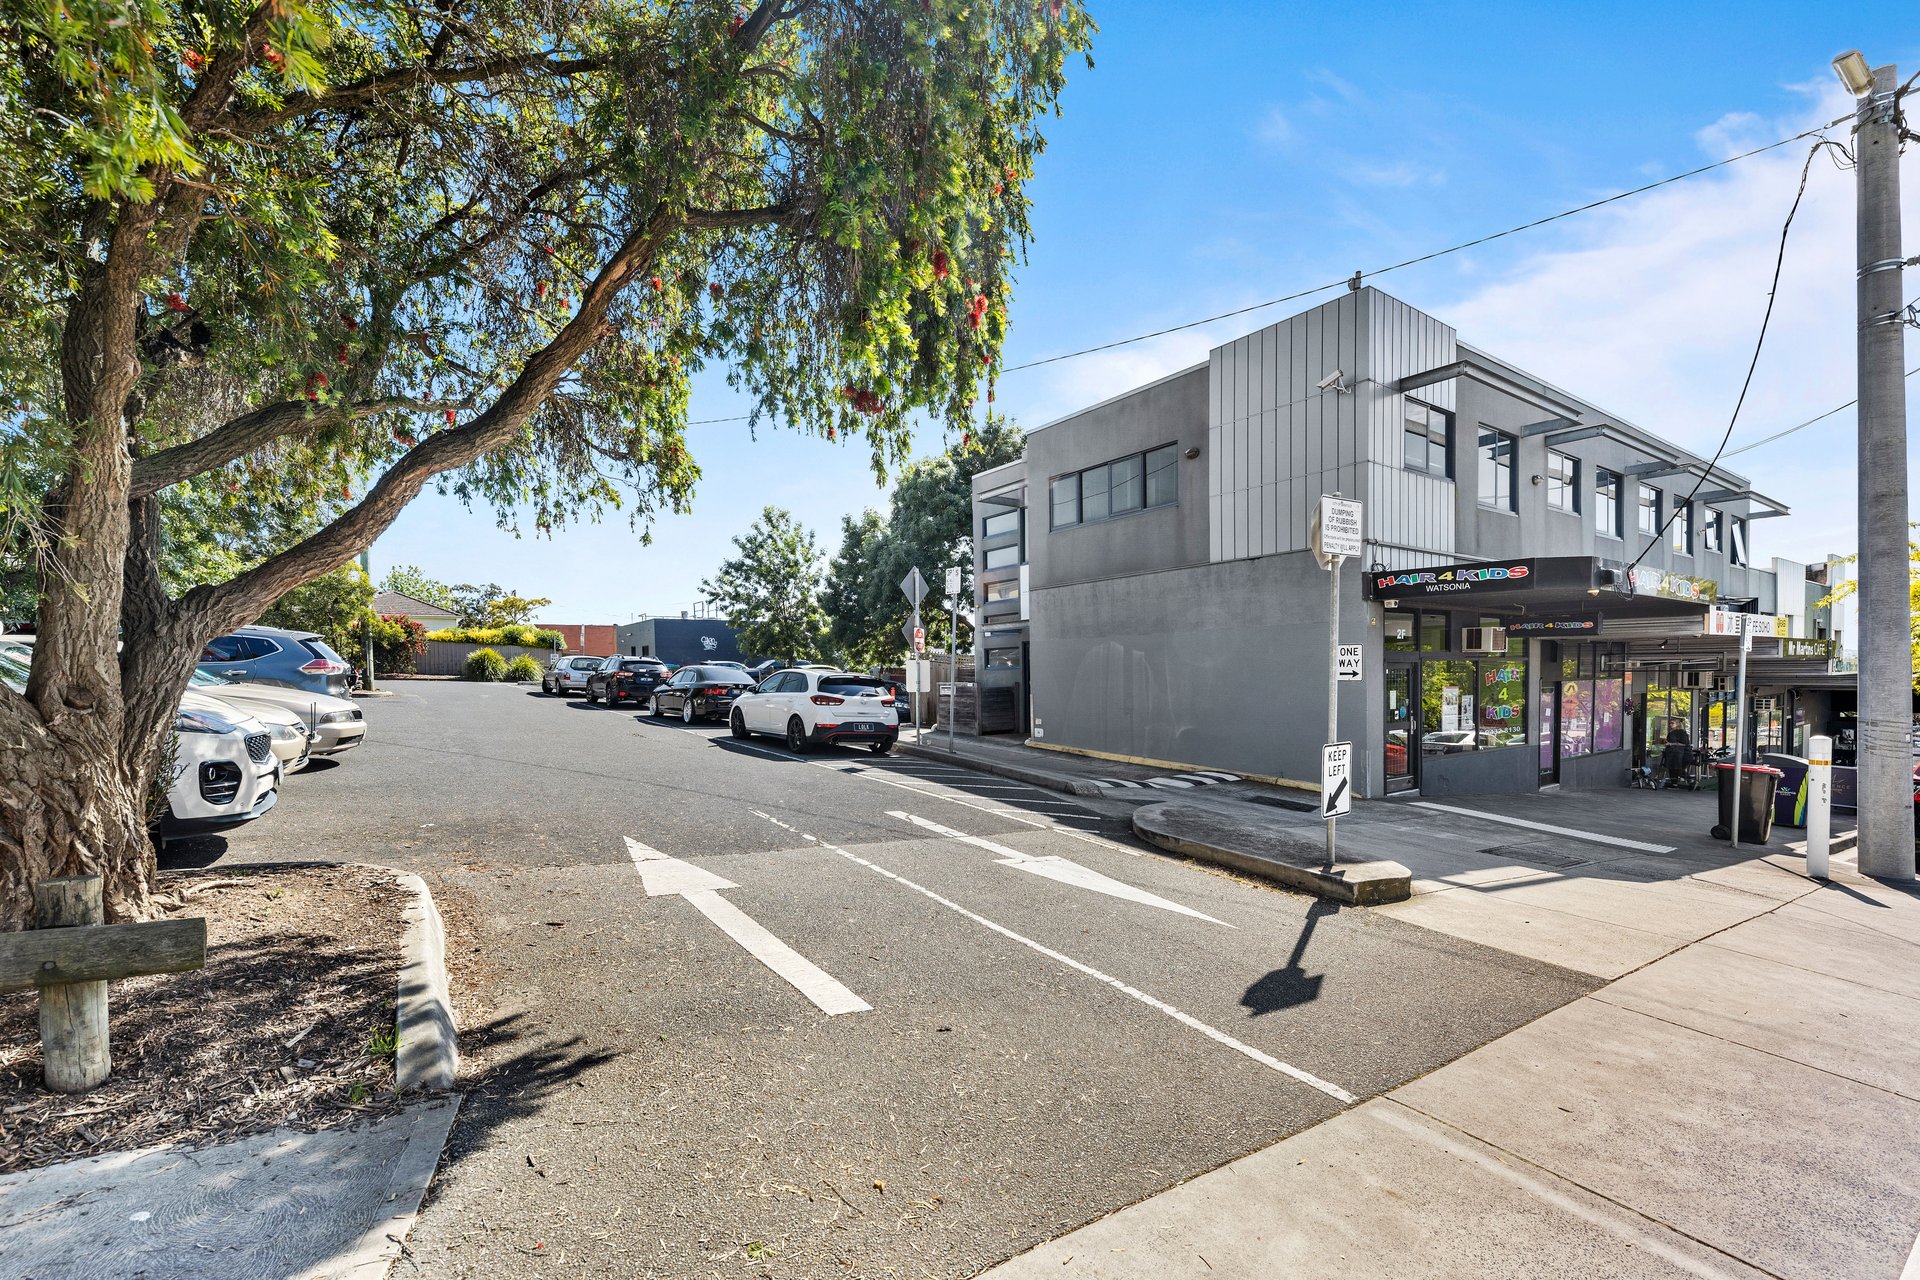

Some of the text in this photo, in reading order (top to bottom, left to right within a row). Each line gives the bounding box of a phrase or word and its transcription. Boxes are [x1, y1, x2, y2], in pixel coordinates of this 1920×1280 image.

[1331, 507, 1354, 518] DUMPING
[1328, 515, 1358, 527] OF RUBBISH
[1324, 523, 1360, 535] IS PROHIBITED
[1377, 565, 1529, 589] HAIR 4 KIDS
[1425, 582, 1471, 592] WATSONIA
[1627, 569, 1700, 600] HAIR 4 KIDS
[1509, 622, 1545, 630] HAIR
[1554, 621, 1594, 629] KIDS
[1759, 620, 1771, 634] SOHO
[1396, 628, 1406, 640] 2F
[1339, 647, 1359, 656] ONE
[1788, 640, 1796, 656] Mr
[1796, 640, 1814, 656] Martins
[1338, 659, 1360, 668] WAY
[1485, 668, 1521, 687] HAIR
[1498, 687, 1509, 701] 4
[1486, 704, 1521, 720] KIDS
[1328, 749, 1347, 762] KEEP
[1328, 764, 1346, 777] LEFT
